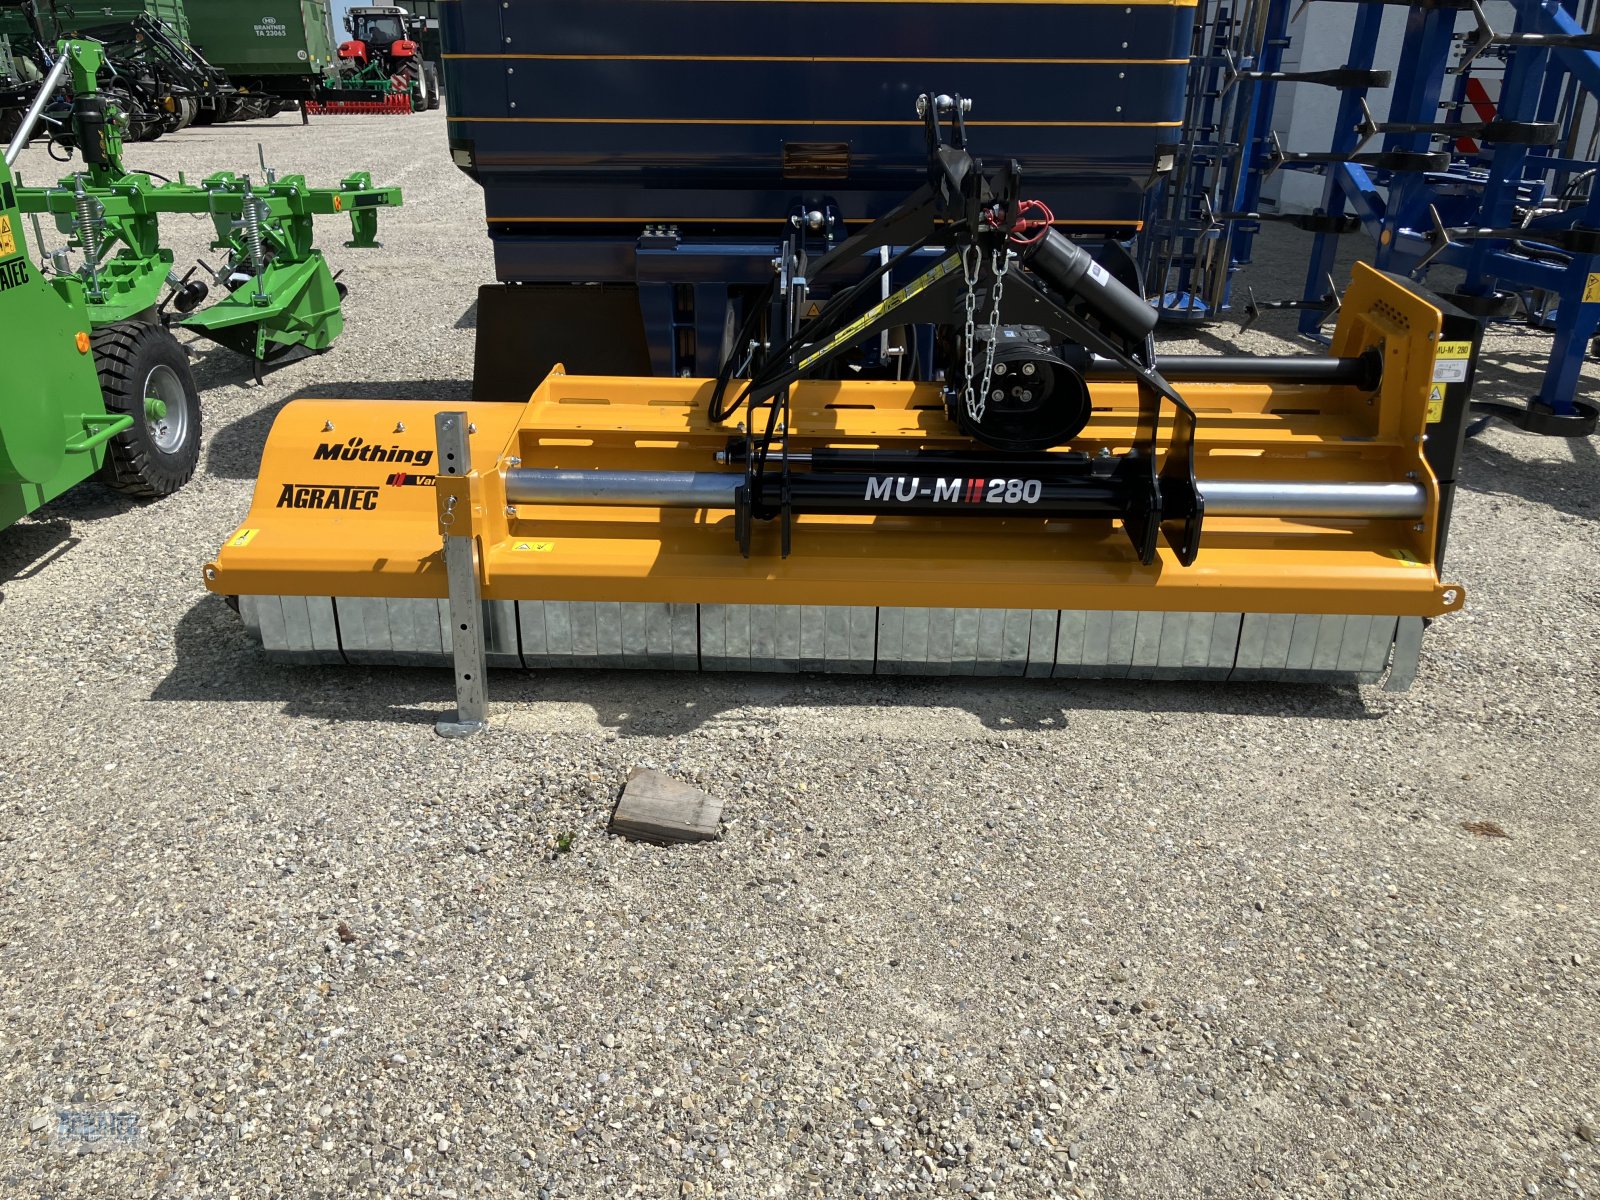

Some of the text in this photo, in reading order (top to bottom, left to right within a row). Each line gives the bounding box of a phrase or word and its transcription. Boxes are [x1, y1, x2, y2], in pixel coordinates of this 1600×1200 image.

[1457, 346, 1469, 354] 280
[313, 437, 433, 466] Müthing
[985, 478, 1042, 504] 280
